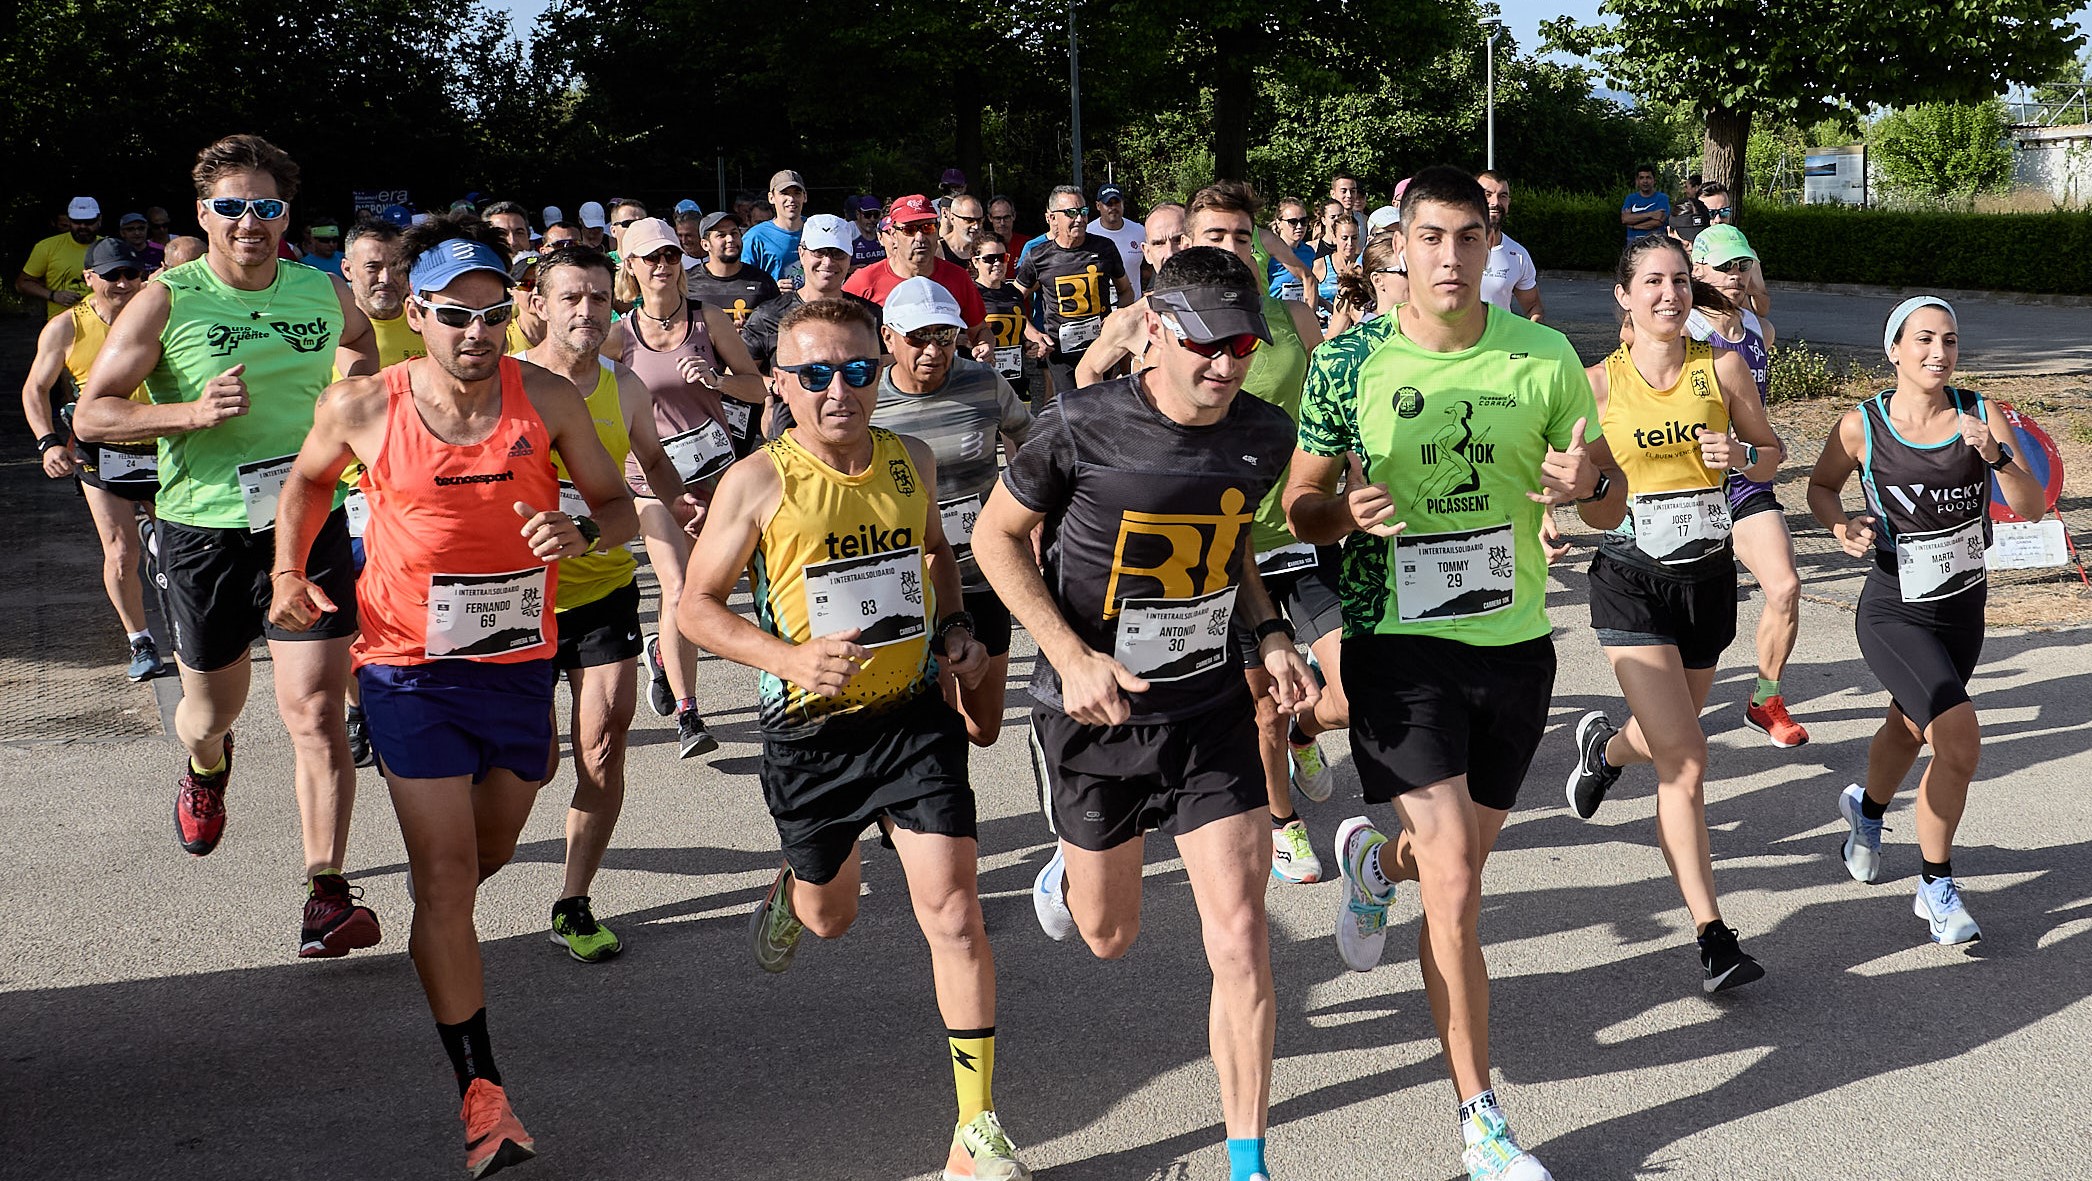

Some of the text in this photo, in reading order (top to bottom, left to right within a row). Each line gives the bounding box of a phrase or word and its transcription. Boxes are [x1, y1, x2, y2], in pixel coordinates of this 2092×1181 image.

[855, 252, 865, 260] EL
[269, 317, 328, 337] Rock
[1633, 421, 1708, 449] teika
[693, 453, 704, 463] 81
[1421, 443, 1495, 465] III 10K
[1929, 482, 1984, 502] VICKY
[1426, 494, 1490, 515] PICASSENT
[1937, 499, 1979, 514] FOODS
[1671, 513, 1693, 525] JOSEP
[1677, 524, 1689, 537] 17
[824, 524, 912, 560] teika
[1422, 543, 1484, 556] INTERTRAILSOLIDARIO
[1931, 551, 1955, 564] MARTA
[1437, 560, 1470, 573] TOMMY
[1940, 562, 1951, 574] 18
[834, 567, 896, 585] INTERTRAILSOLIDARIO
[1446, 573, 1463, 588] 29
[458, 585, 520, 597] INTERTRAILSOLIDARIO
[465, 600, 511, 614] FERNANDO
[861, 599, 878, 616] 83
[1149, 607, 1210, 620] INTERTRAILSOLIDARIO
[480, 613, 497, 628] 69
[1159, 624, 1197, 638] ANTONIO
[1168, 638, 1186, 652] 30
